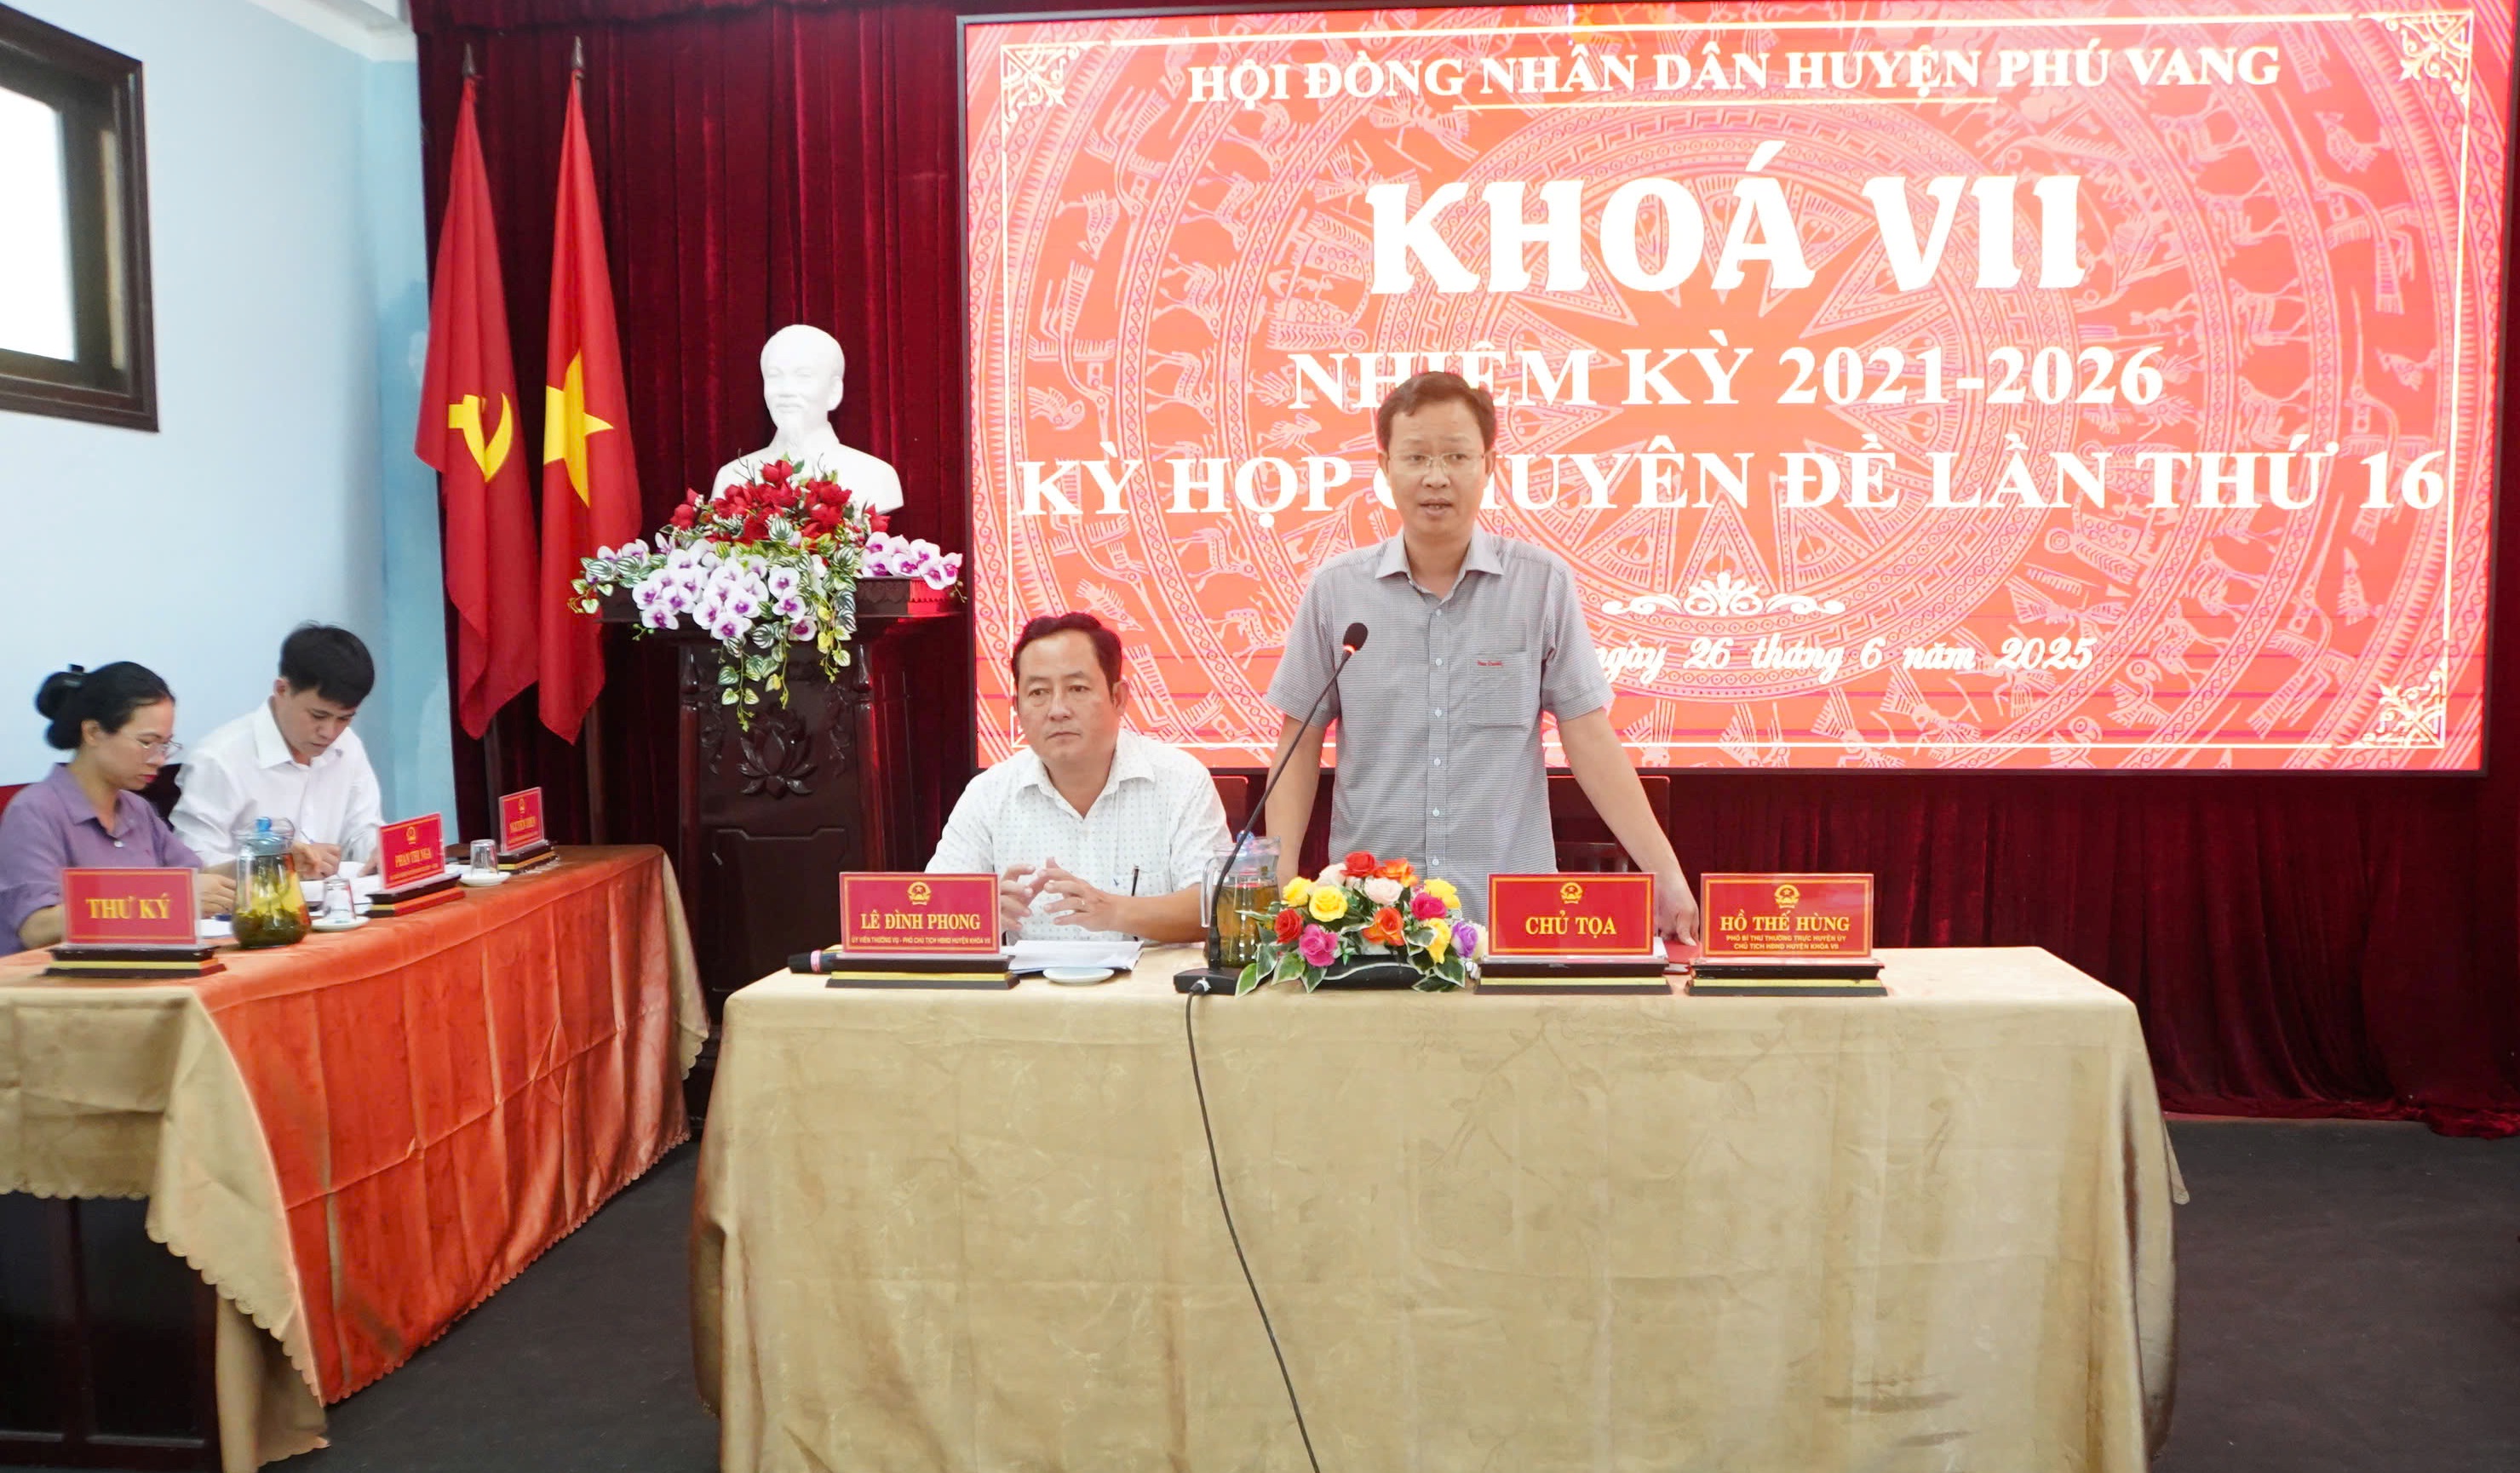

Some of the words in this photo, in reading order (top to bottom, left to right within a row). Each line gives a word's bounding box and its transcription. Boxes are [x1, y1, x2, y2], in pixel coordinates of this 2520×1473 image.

[1188, 61, 1290, 110] HỘI
[1304, 52, 1464, 100] ĐỒNG
[1480, 43, 1639, 95] NHÂN
[1654, 42, 1769, 90] DÂN
[1785, 44, 1979, 99] HUYỆN
[1996, 38, 2110, 88] PHÚ
[2127, 46, 2281, 87] VANG
[1365, 140, 1816, 295] KHOÁ
[1862, 175, 2086, 292] VII
[1622, 330, 1754, 405] KỲ
[1778, 345, 2164, 406] 2021-2026
[1018, 441, 1146, 516] KỲ
[1164, 455, 1352, 529] HỌP
[1778, 434, 1900, 509] ĐỀ
[1927, 435, 2108, 509] LẦN
[2133, 434, 2339, 511] THỨ
[2358, 452, 2445, 511] 16
[1683, 637, 1734, 670] 26
[1750, 633, 1846, 685] tháng
[1860, 637, 1886, 670] 6
[1903, 642, 1976, 670] năm
[1995, 637, 2098, 670] 2025
[85, 896, 135, 919] THƯ
[139, 892, 171, 919] KÝ
[860, 909, 880, 930] LÊ
[884, 909, 923, 930] ĐÌNH
[927, 913, 981, 930] PHONG
[1525, 910, 1569, 935] CHỦ
[1575, 916, 1616, 938] TỌA
[1720, 909, 1748, 931] HỒ
[1753, 910, 1790, 931] THẾ
[1795, 913, 1850, 931] HÙNG
